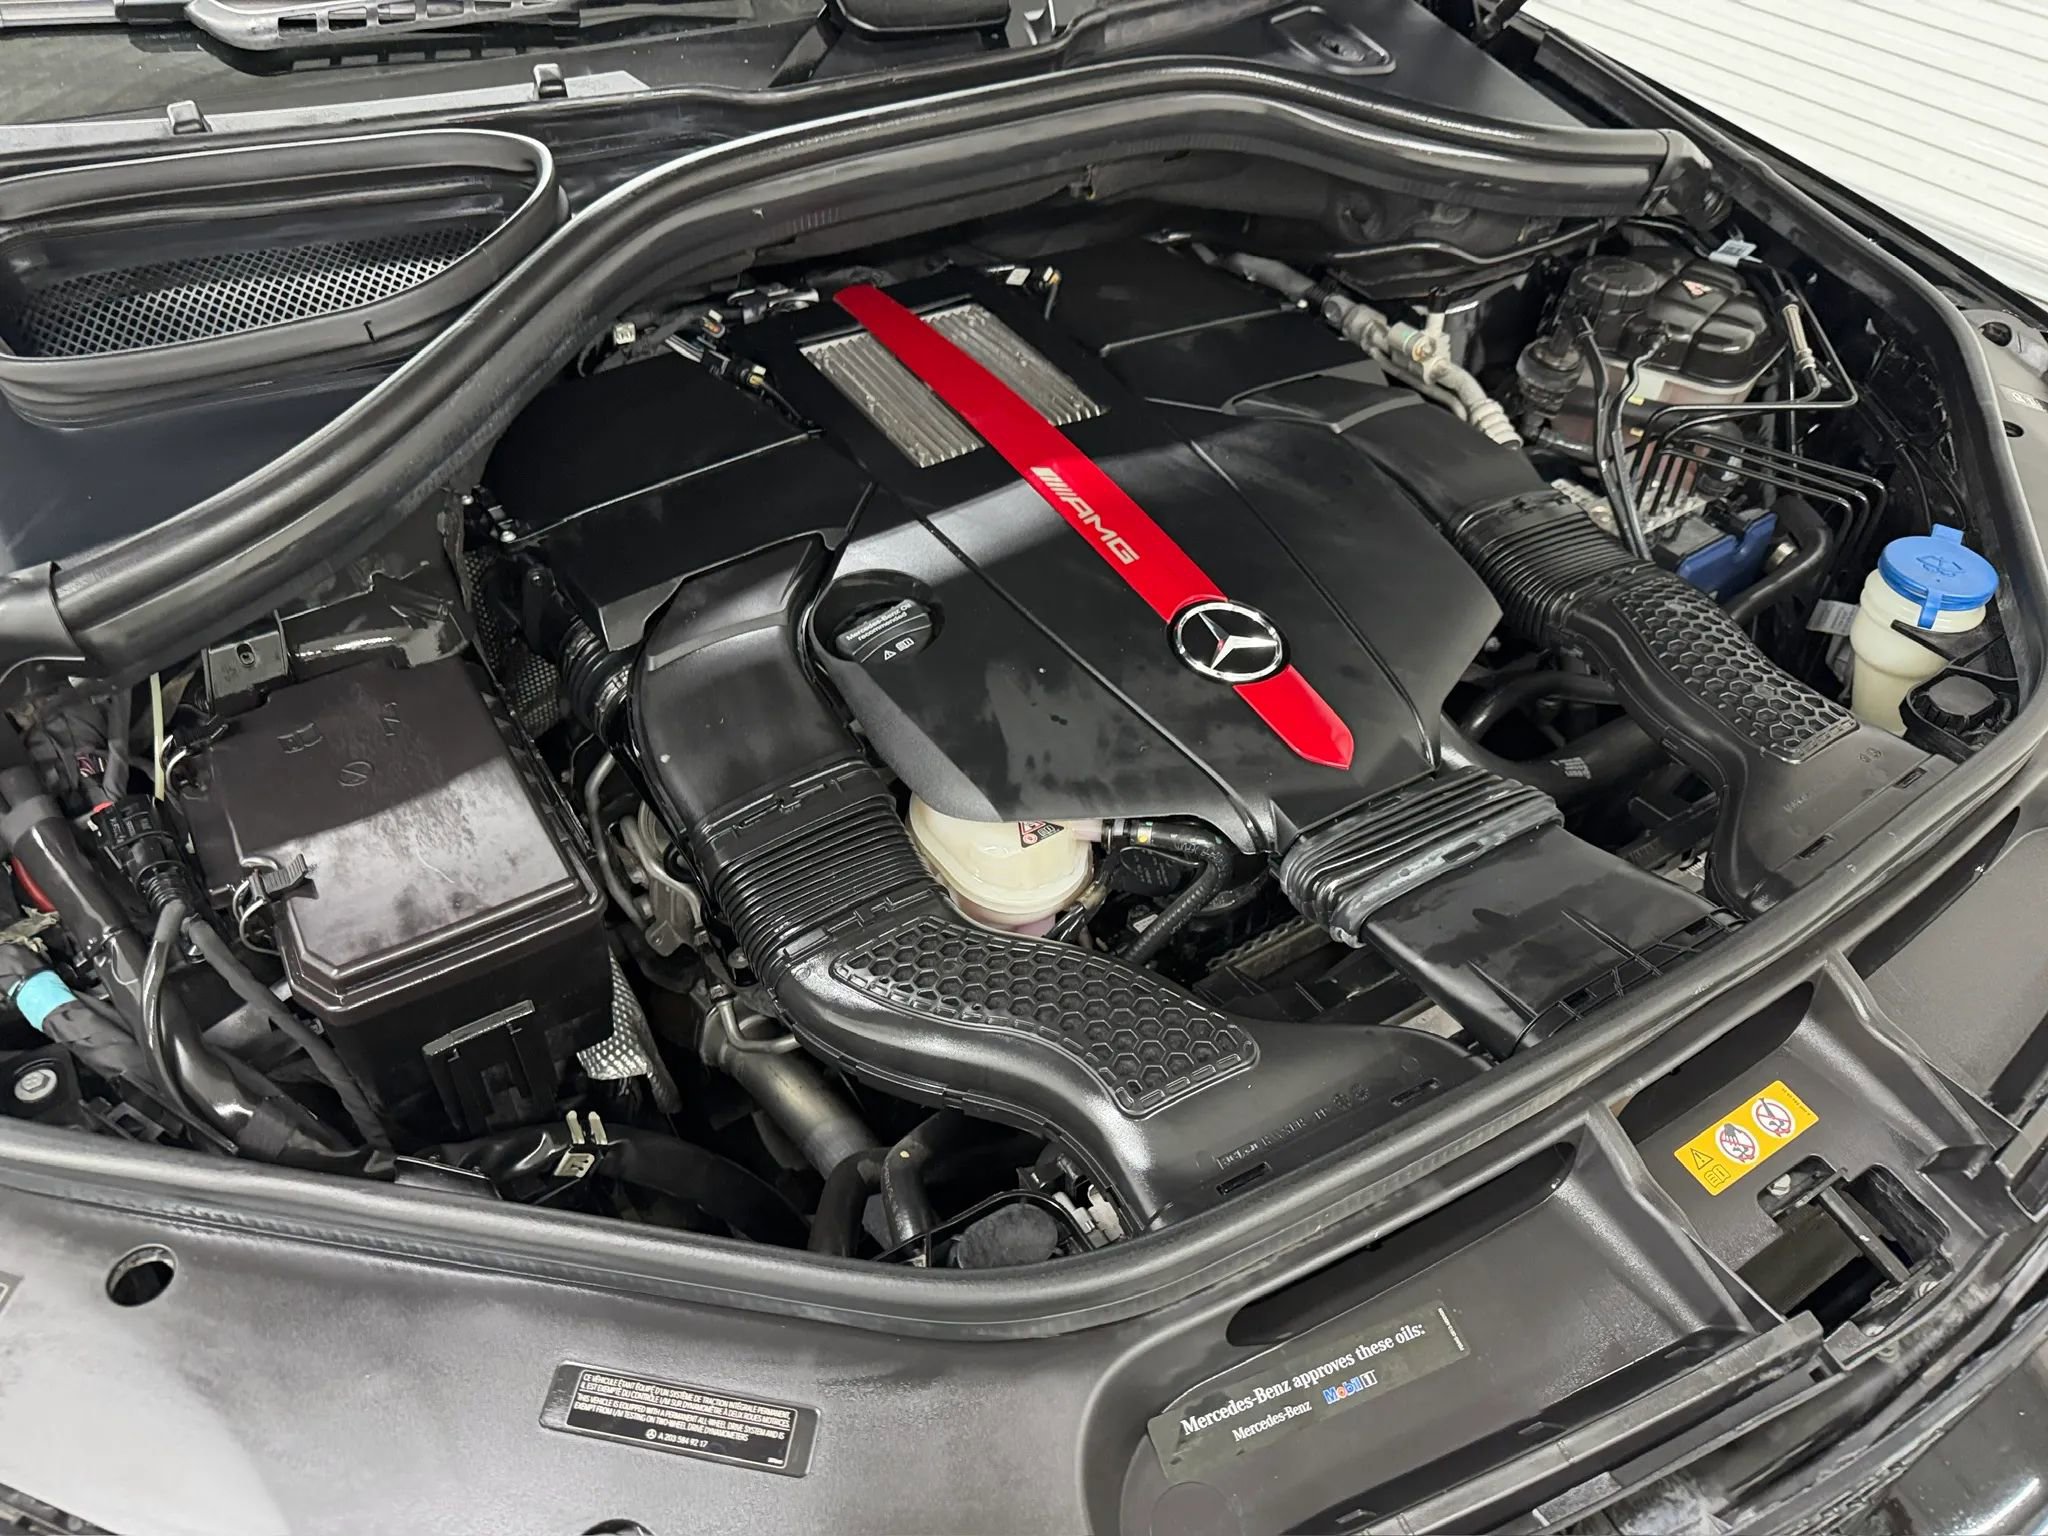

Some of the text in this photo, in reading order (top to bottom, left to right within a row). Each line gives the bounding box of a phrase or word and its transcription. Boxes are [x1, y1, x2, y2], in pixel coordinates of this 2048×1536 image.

[1058, 494, 1140, 565] AMG
[1180, 1380, 1292, 1435] Mercedes-Benz
[1292, 1354, 1355, 1389] approves
[1355, 1337, 1394, 1361] these
[1395, 1324, 1426, 1344] oils:
[622, 1389, 631, 1397] DU
[694, 1395, 703, 1403] DE
[591, 1396, 614, 1407] VEHICLE
[613, 1400, 620, 1408] IS
[619, 1401, 646, 1413] EQUIPPED
[1232, 1401, 1312, 1441] Mercedes-Benz
[1323, 1377, 1363, 1404] Mobil
[658, 1432, 708, 1449] A 203 584 92 17
